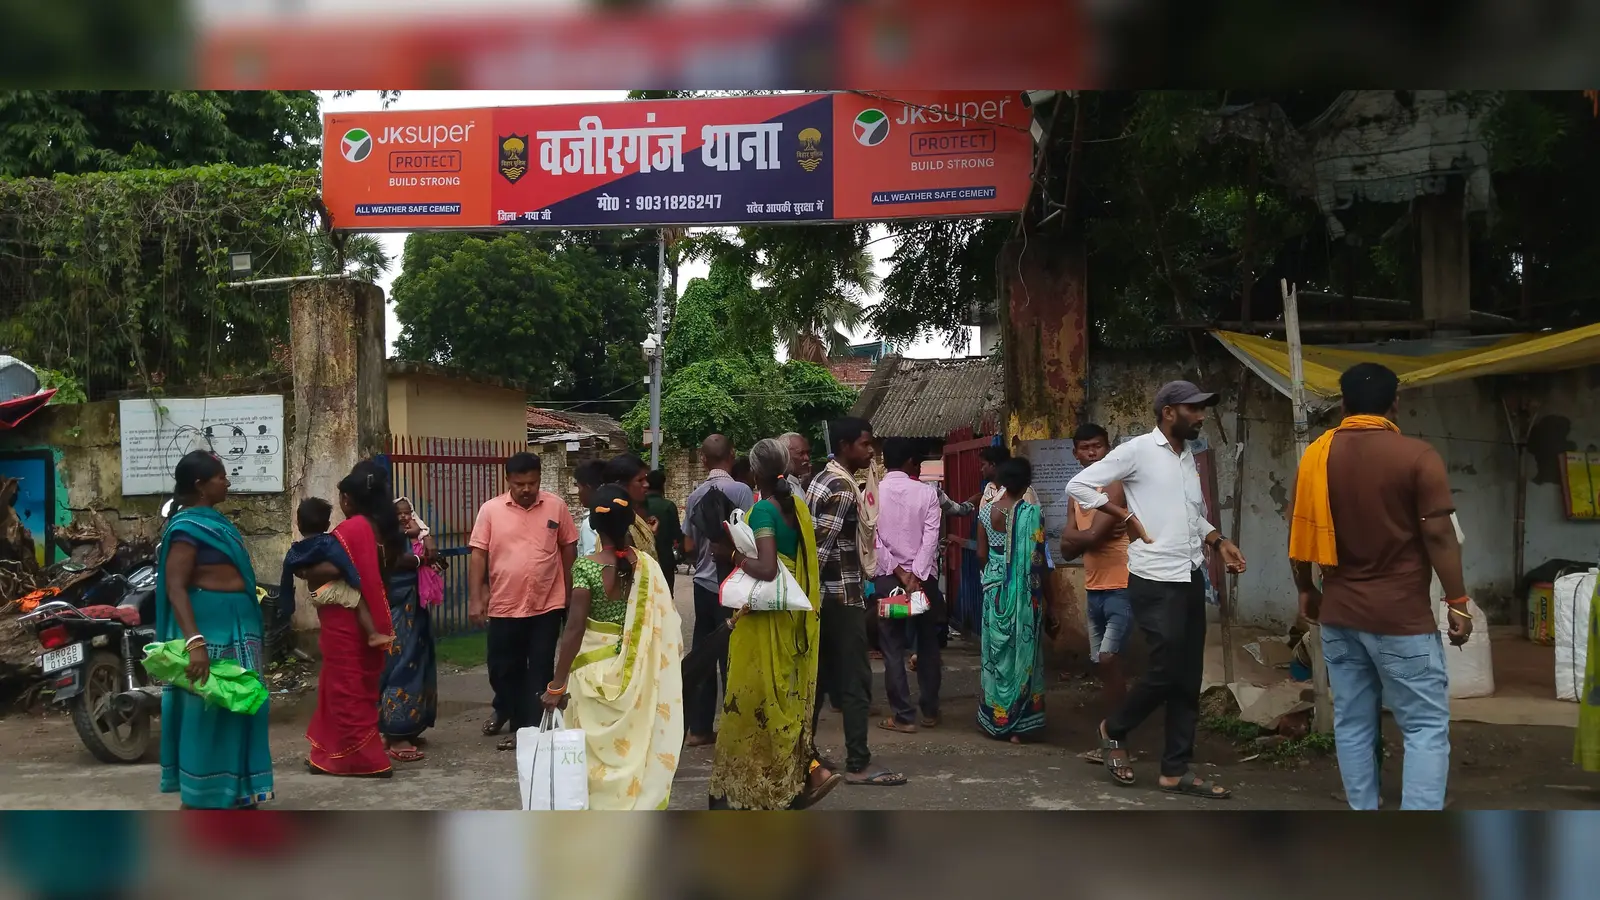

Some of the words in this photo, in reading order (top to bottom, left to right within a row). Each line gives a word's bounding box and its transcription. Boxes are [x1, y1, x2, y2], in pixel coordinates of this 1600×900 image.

[536, 112, 686, 175] वजीरगंज
[701, 122, 783, 171] थाना
[918, 134, 987, 150] PROTECT
[396, 155, 456, 168] PROTECT
[911, 160, 943, 171] BUILD
[947, 158, 994, 169] STRONG
[389, 177, 417, 187] BUILD
[420, 176, 460, 186] STRONG
[636, 194, 722, 211] 9031826247
[873, 195, 890, 203] ALL
[891, 191, 932, 202] WEATHER
[934, 190, 956, 200] SAFE
[958, 188, 994, 199] CEMENT
[356, 206, 370, 214] ALL
[371, 205, 406, 213] WEATHER
[408, 205, 428, 213] SAFE
[429, 205, 460, 213] CEMENT
[497, 209, 517, 221] जिला
[525, 211, 540, 221] गया
[541, 208, 552, 220] जी
[746, 201, 764, 214] सदैव
[766, 201, 792, 213] आपकी
[793, 202, 814, 216] सुरक्षा
[816, 199, 825, 212] में
